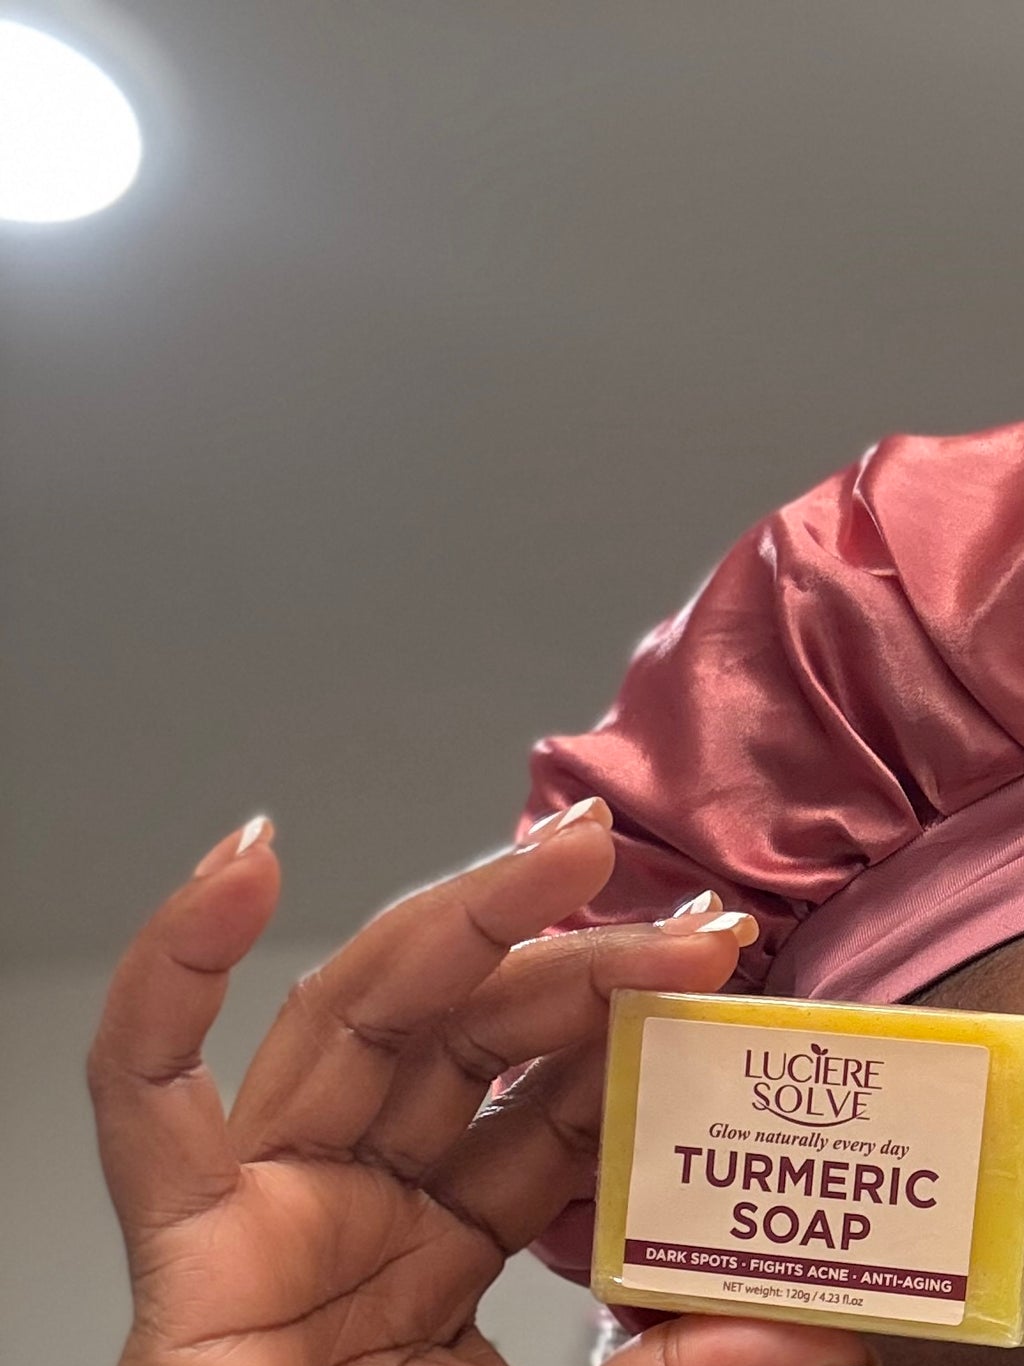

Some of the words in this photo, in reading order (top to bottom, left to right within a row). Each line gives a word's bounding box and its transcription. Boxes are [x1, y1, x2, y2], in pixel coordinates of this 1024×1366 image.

[744, 1046, 885, 1090] LUCIERE
[751, 1082, 873, 1122] SOLVE
[709, 1122, 751, 1141] Glow
[754, 1132, 829, 1151] naturally
[832, 1137, 876, 1157] every
[879, 1139, 910, 1160] day
[674, 1145, 941, 1209] TURMERIC
[729, 1201, 872, 1251] SOAP
[645, 1247, 687, 1264] DARK
[690, 1252, 738, 1269] SPOTS
[749, 1259, 804, 1277] FIGHTS
[807, 1267, 849, 1282] ACNE
[860, 1273, 953, 1294] ANTI-AGING
[722, 1281, 744, 1293] NET
[745, 1285, 784, 1299] weight:
[786, 1288, 811, 1303] 120g
[819, 1292, 840, 1304] 4.23
